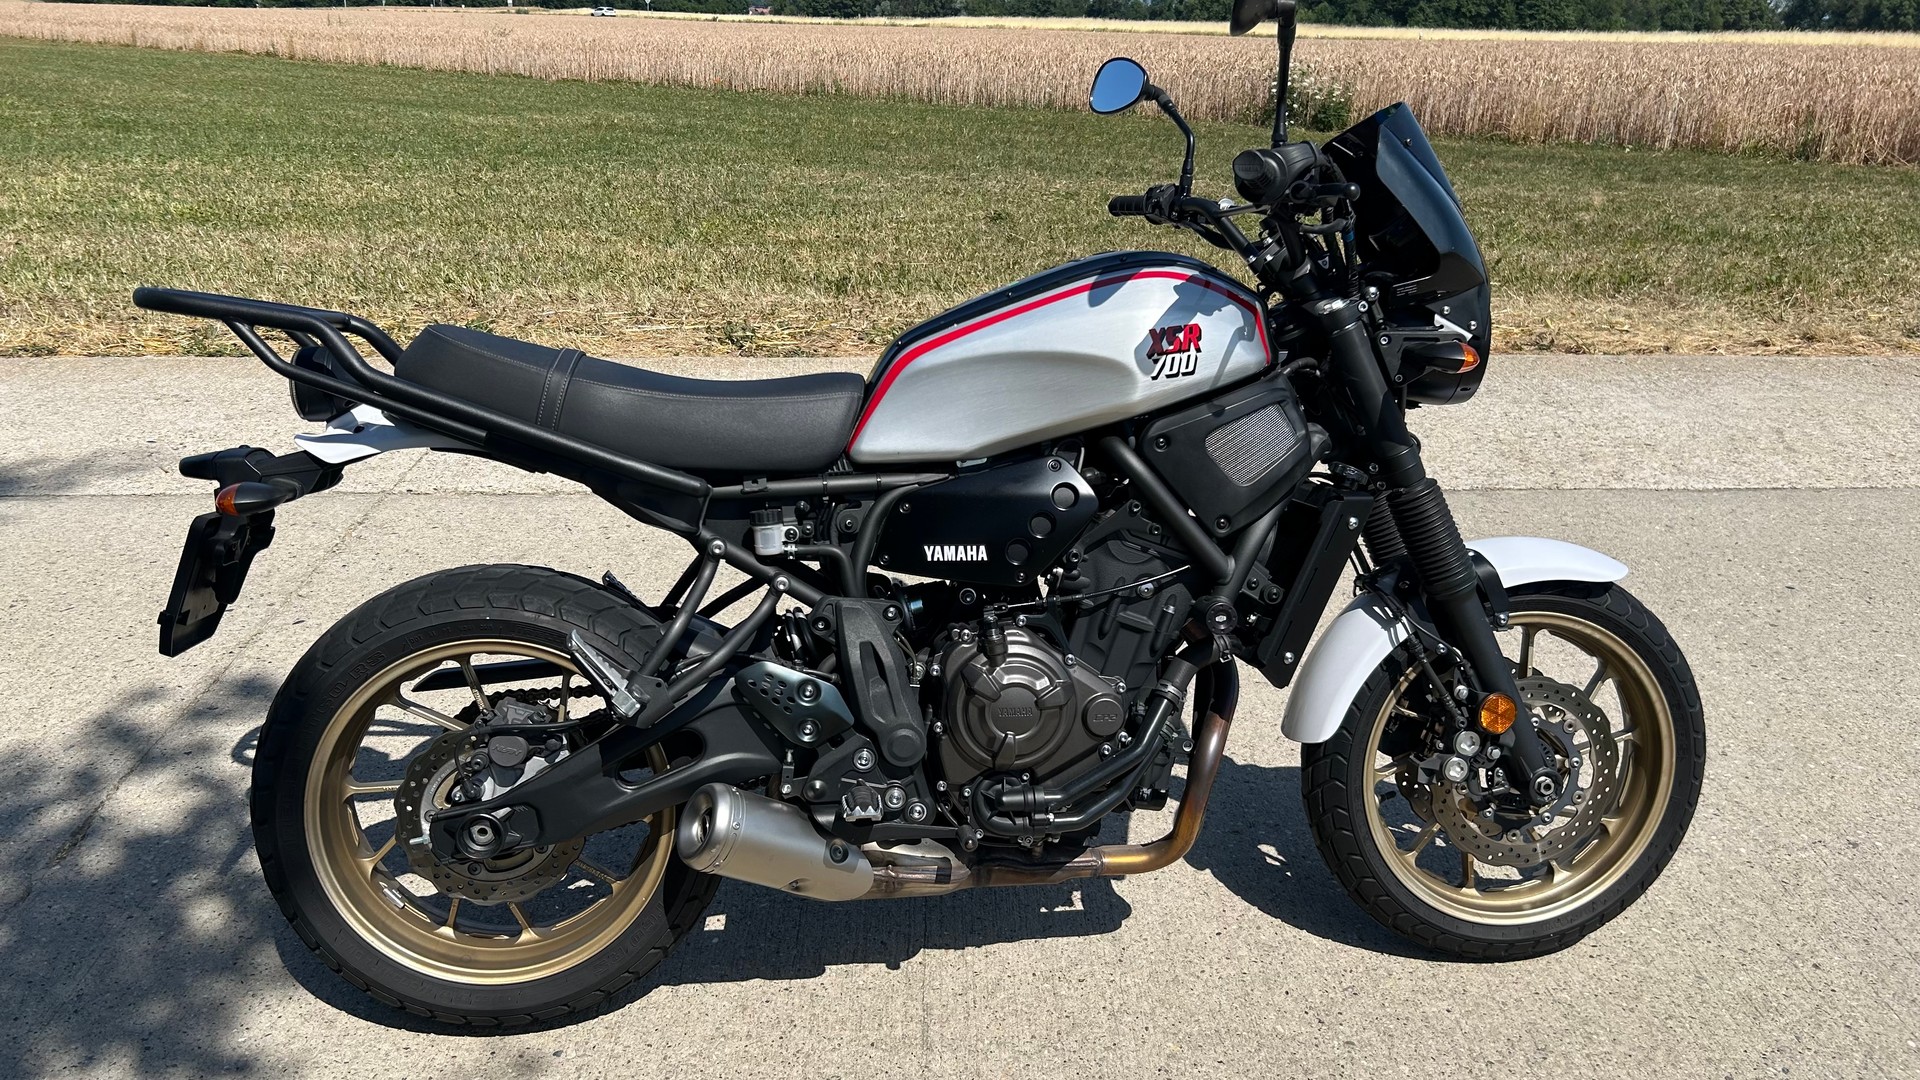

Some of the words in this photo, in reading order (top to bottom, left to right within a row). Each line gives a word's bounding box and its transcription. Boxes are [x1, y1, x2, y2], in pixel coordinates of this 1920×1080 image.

[1146, 323, 1202, 359] XSR
[1151, 351, 1198, 380] 700
[923, 545, 988, 561] YAMAHA
[347, 650, 387, 680] RS
[998, 707, 1033, 717] YAMAHA
